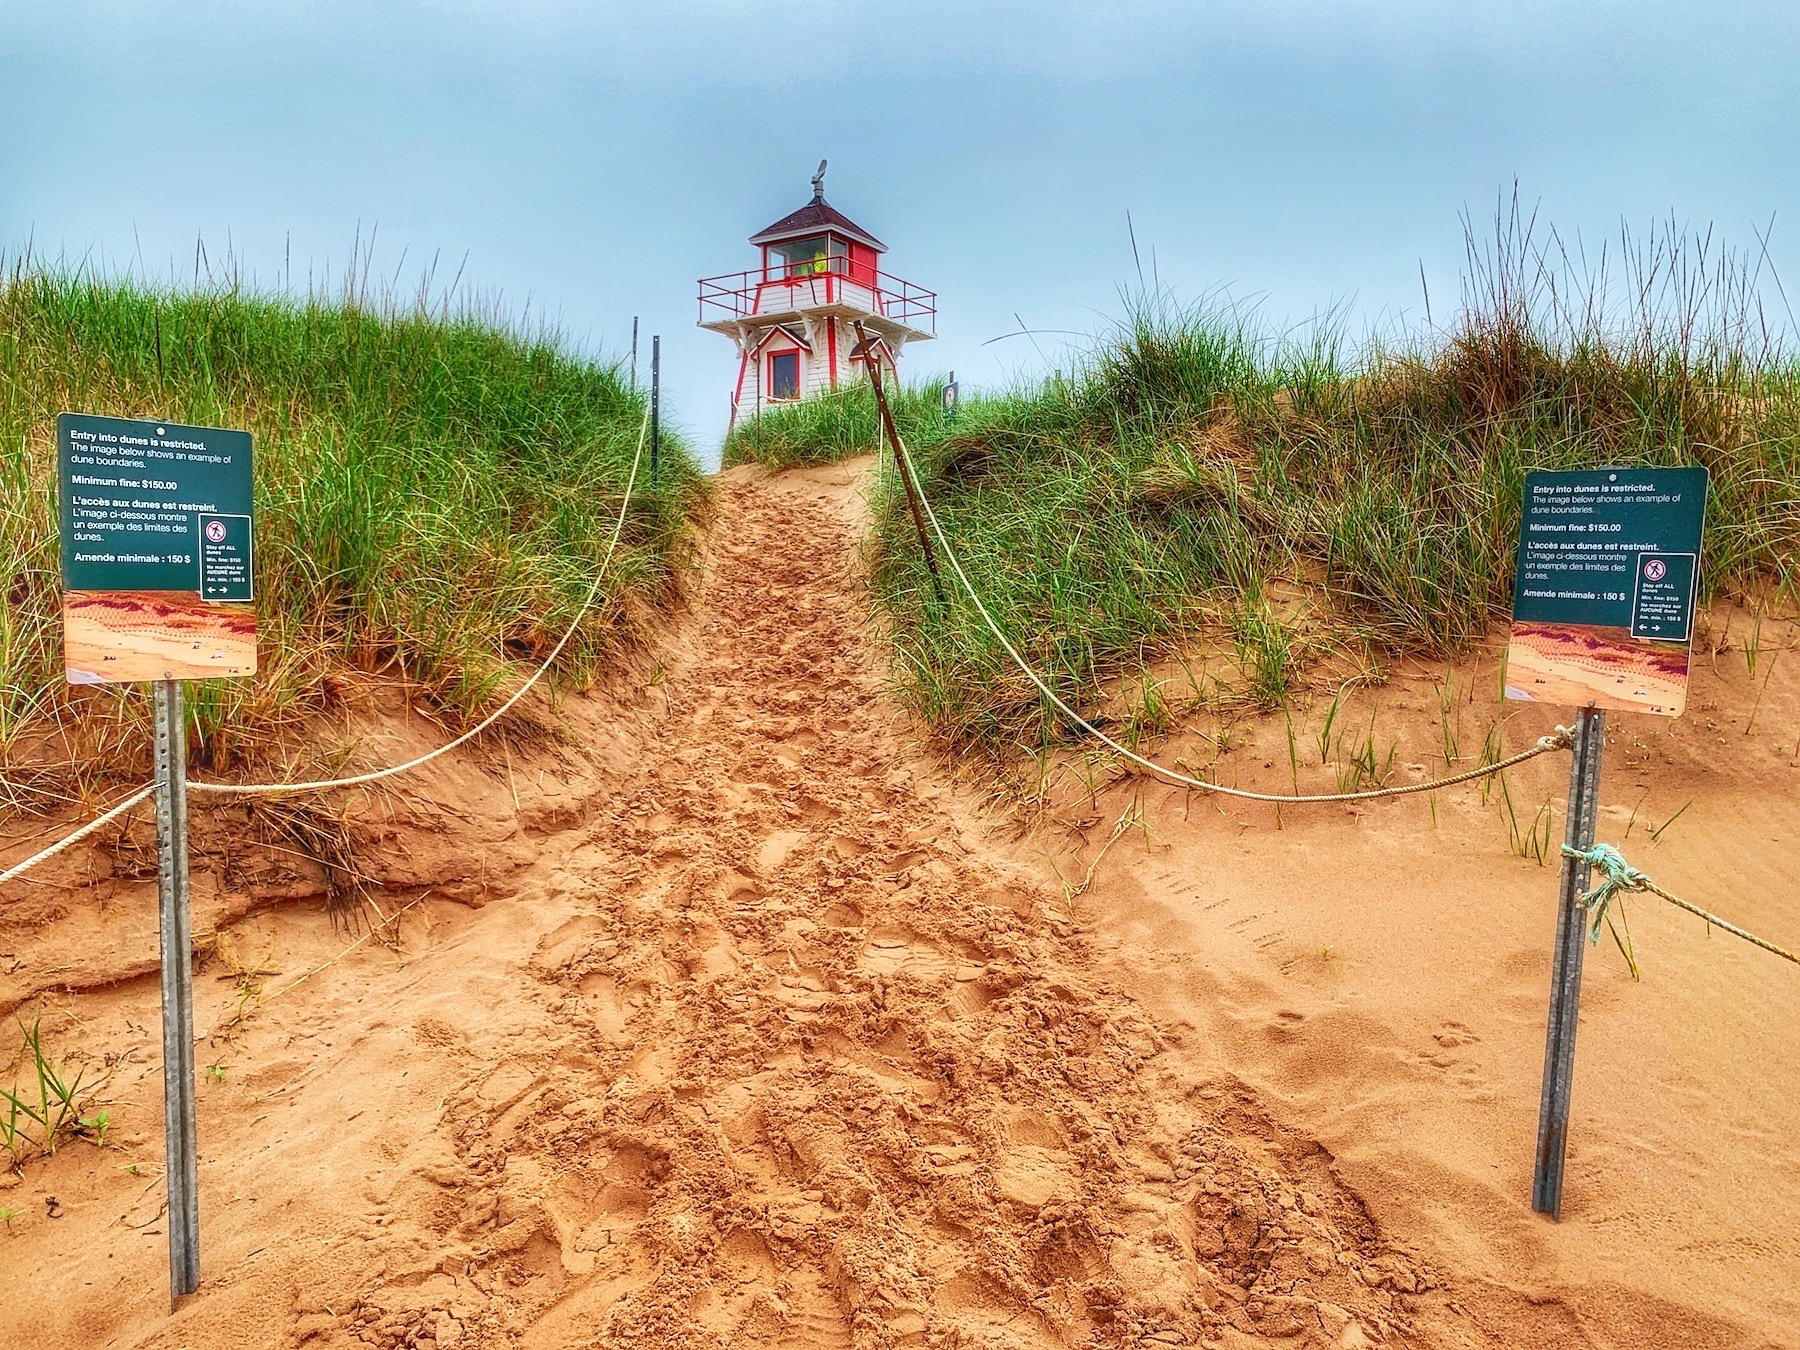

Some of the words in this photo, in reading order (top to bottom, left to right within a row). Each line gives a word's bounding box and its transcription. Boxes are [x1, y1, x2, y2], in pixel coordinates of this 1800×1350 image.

[70, 430, 96, 442] Entry
[99, 433, 117, 442] into
[120, 435, 148, 446] dunes
[150, 438, 158, 446] is
[161, 440, 206, 450] restricted.
[71, 442, 88, 451] The
[90, 444, 117, 455] image
[119, 446, 145, 456] below
[147, 450, 174, 459] shows
[188, 454, 221, 464] example
[71, 455, 94, 464] dune
[96, 457, 146, 468] boundaries.
[72, 475, 117, 486] Minimum
[120, 478, 140, 488] fine:
[142, 480, 177, 490] $150.00
[73, 496, 110, 506] L'accès
[132, 499, 160, 509] dunes
[179, 503, 217, 511] restreint.
[1548, 496, 1570, 505] image
[1636, 495, 1670, 503] example
[73, 508, 107, 519] L'image
[109, 510, 156, 520] ci-dessous
[158, 513, 187, 522] montre
[87, 522, 124, 532] exemple
[127, 522, 142, 531] des
[144, 524, 171, 532] limites
[173, 524, 187, 533] des
[1588, 524, 1621, 532] $150.00
[74, 532, 104, 541] dunes.
[74, 552, 115, 562] Amende
[118, 554, 159, 563] minimale
[184, 555, 191, 564] $
[1527, 552, 1555, 561] L'image
[1536, 563, 1567, 571] exemple
[1523, 589, 1556, 598] Amende
[1558, 590, 1595, 600] minimale
[1603, 592, 1617, 600] 150
[1619, 592, 1625, 601] $
